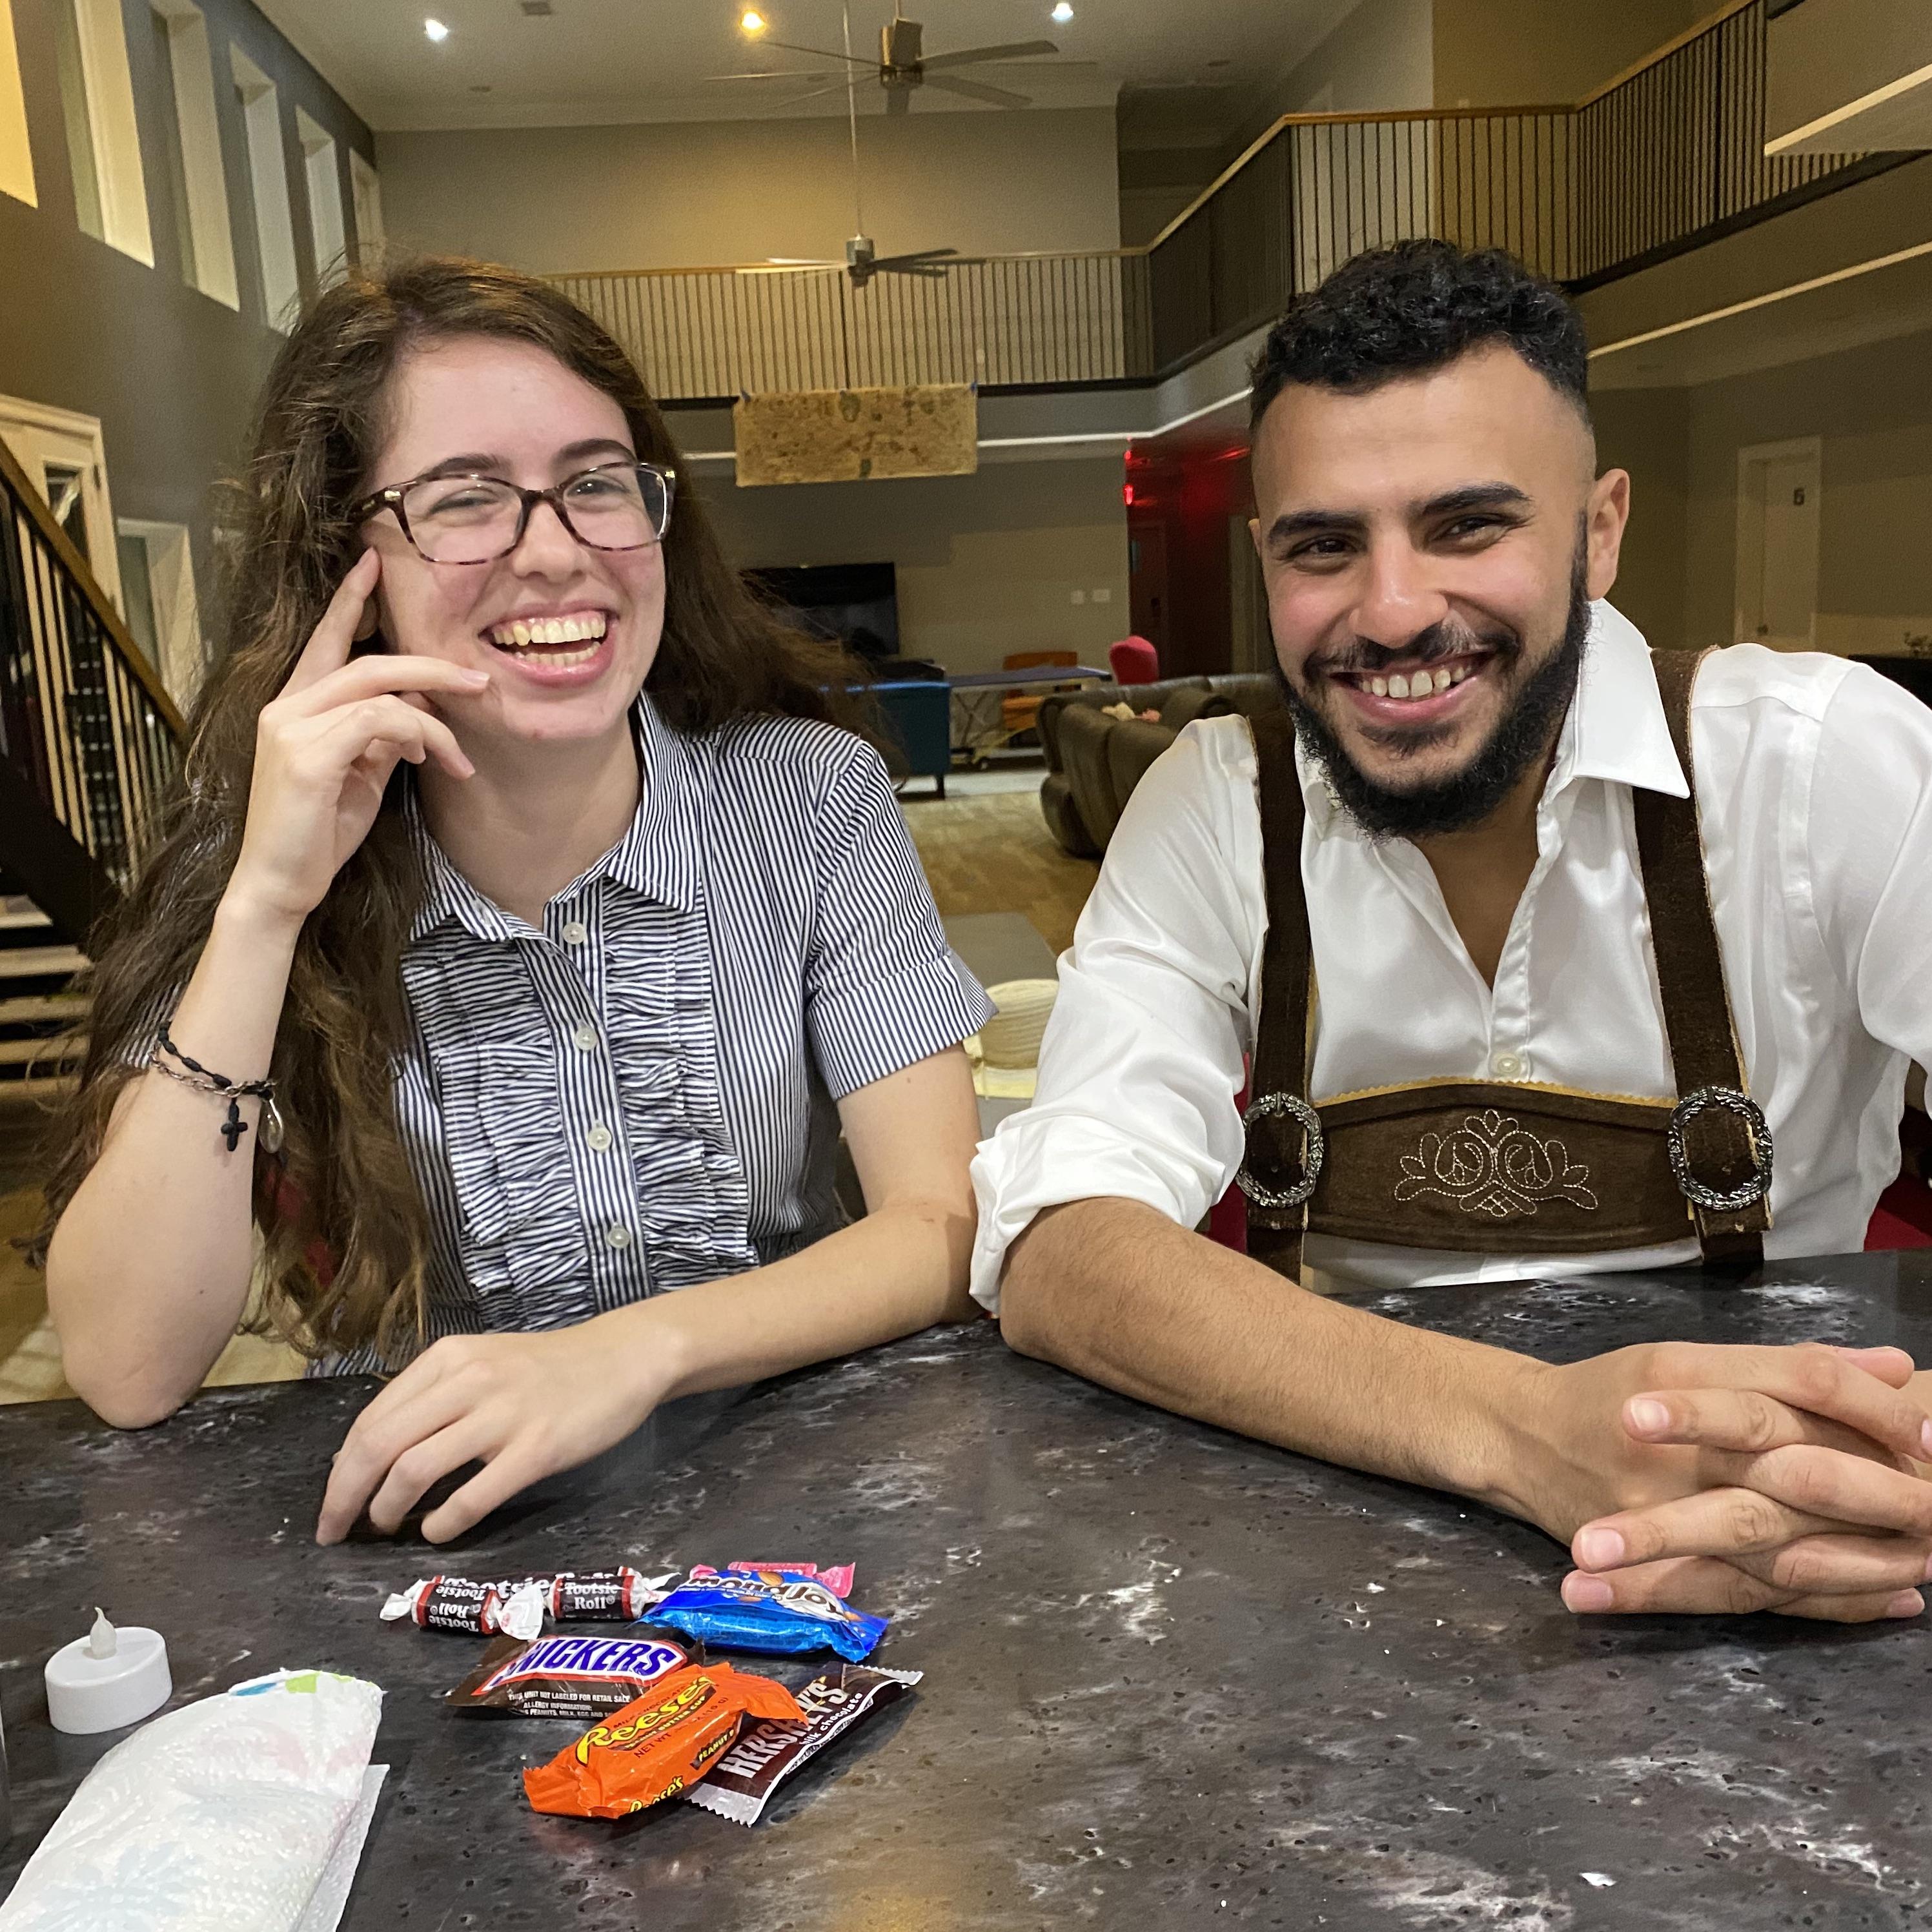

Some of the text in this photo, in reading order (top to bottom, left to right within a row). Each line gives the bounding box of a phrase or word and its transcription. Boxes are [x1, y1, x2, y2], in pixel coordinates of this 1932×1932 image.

[436, 1584, 486, 1601] Tootsie
[564, 1582, 618, 1595] Tootsie
[429, 1615, 479, 1632] Tootsie
[492, 1639, 678, 1683] NICKERS
[524, 1701, 549, 1709] ALLERGY
[551, 1693, 578, 1701] LABELED
[592, 1694, 613, 1703] RETAIL
[633, 1741, 655, 1759] NET
